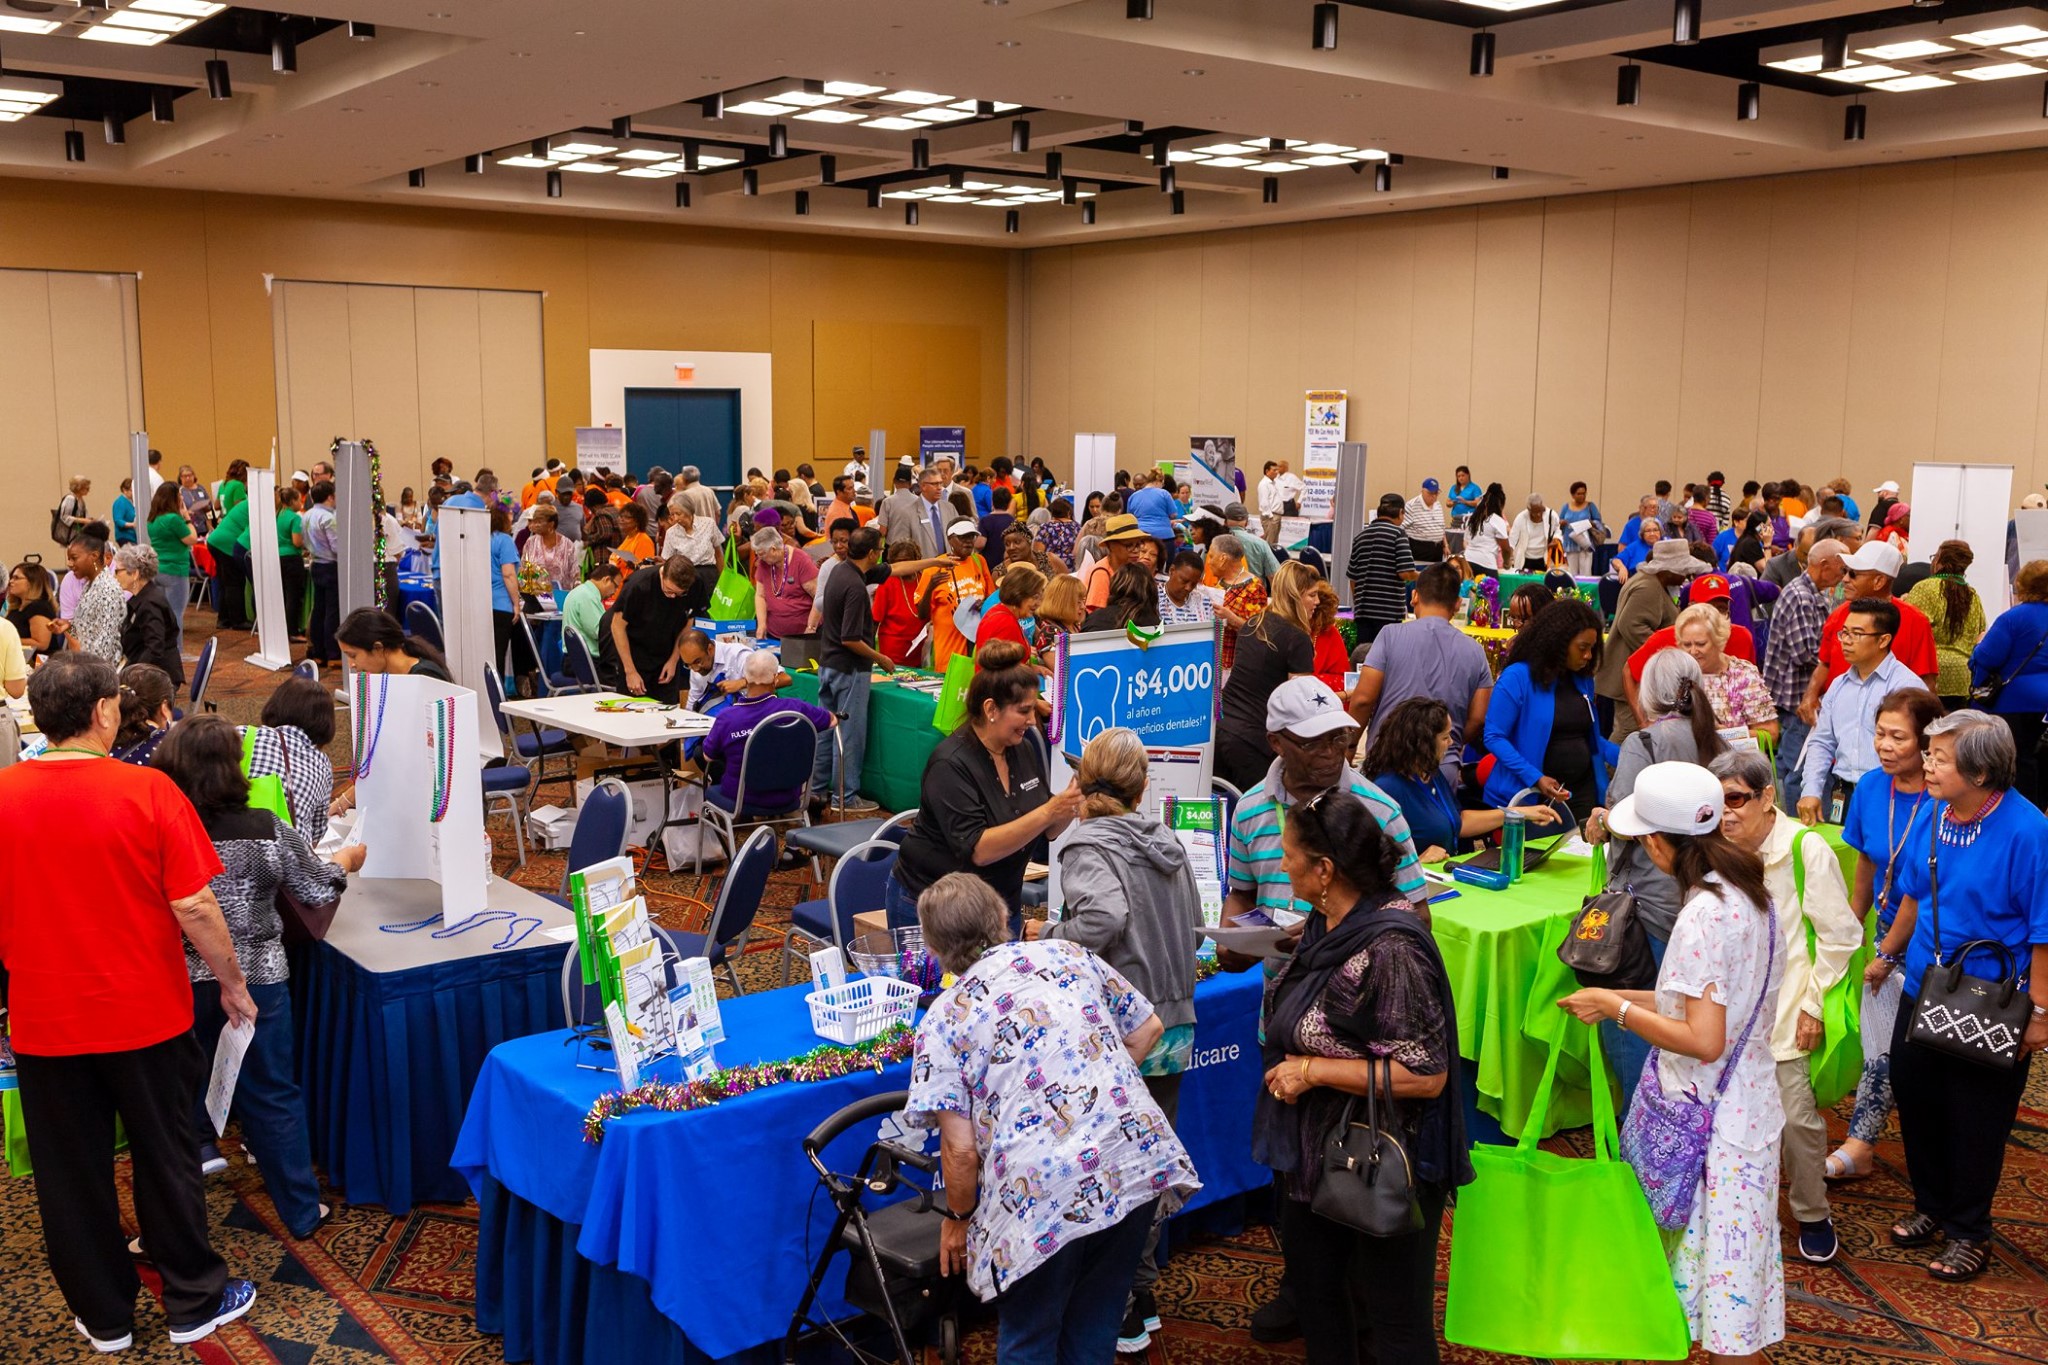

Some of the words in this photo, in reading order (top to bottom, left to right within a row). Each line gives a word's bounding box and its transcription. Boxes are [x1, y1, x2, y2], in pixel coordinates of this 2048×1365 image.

[1127, 662, 1212, 704] ¡$4,000
[1126, 710, 1134, 720] al
[1136, 707, 1150, 718] año
[1152, 706, 1161, 716] en
